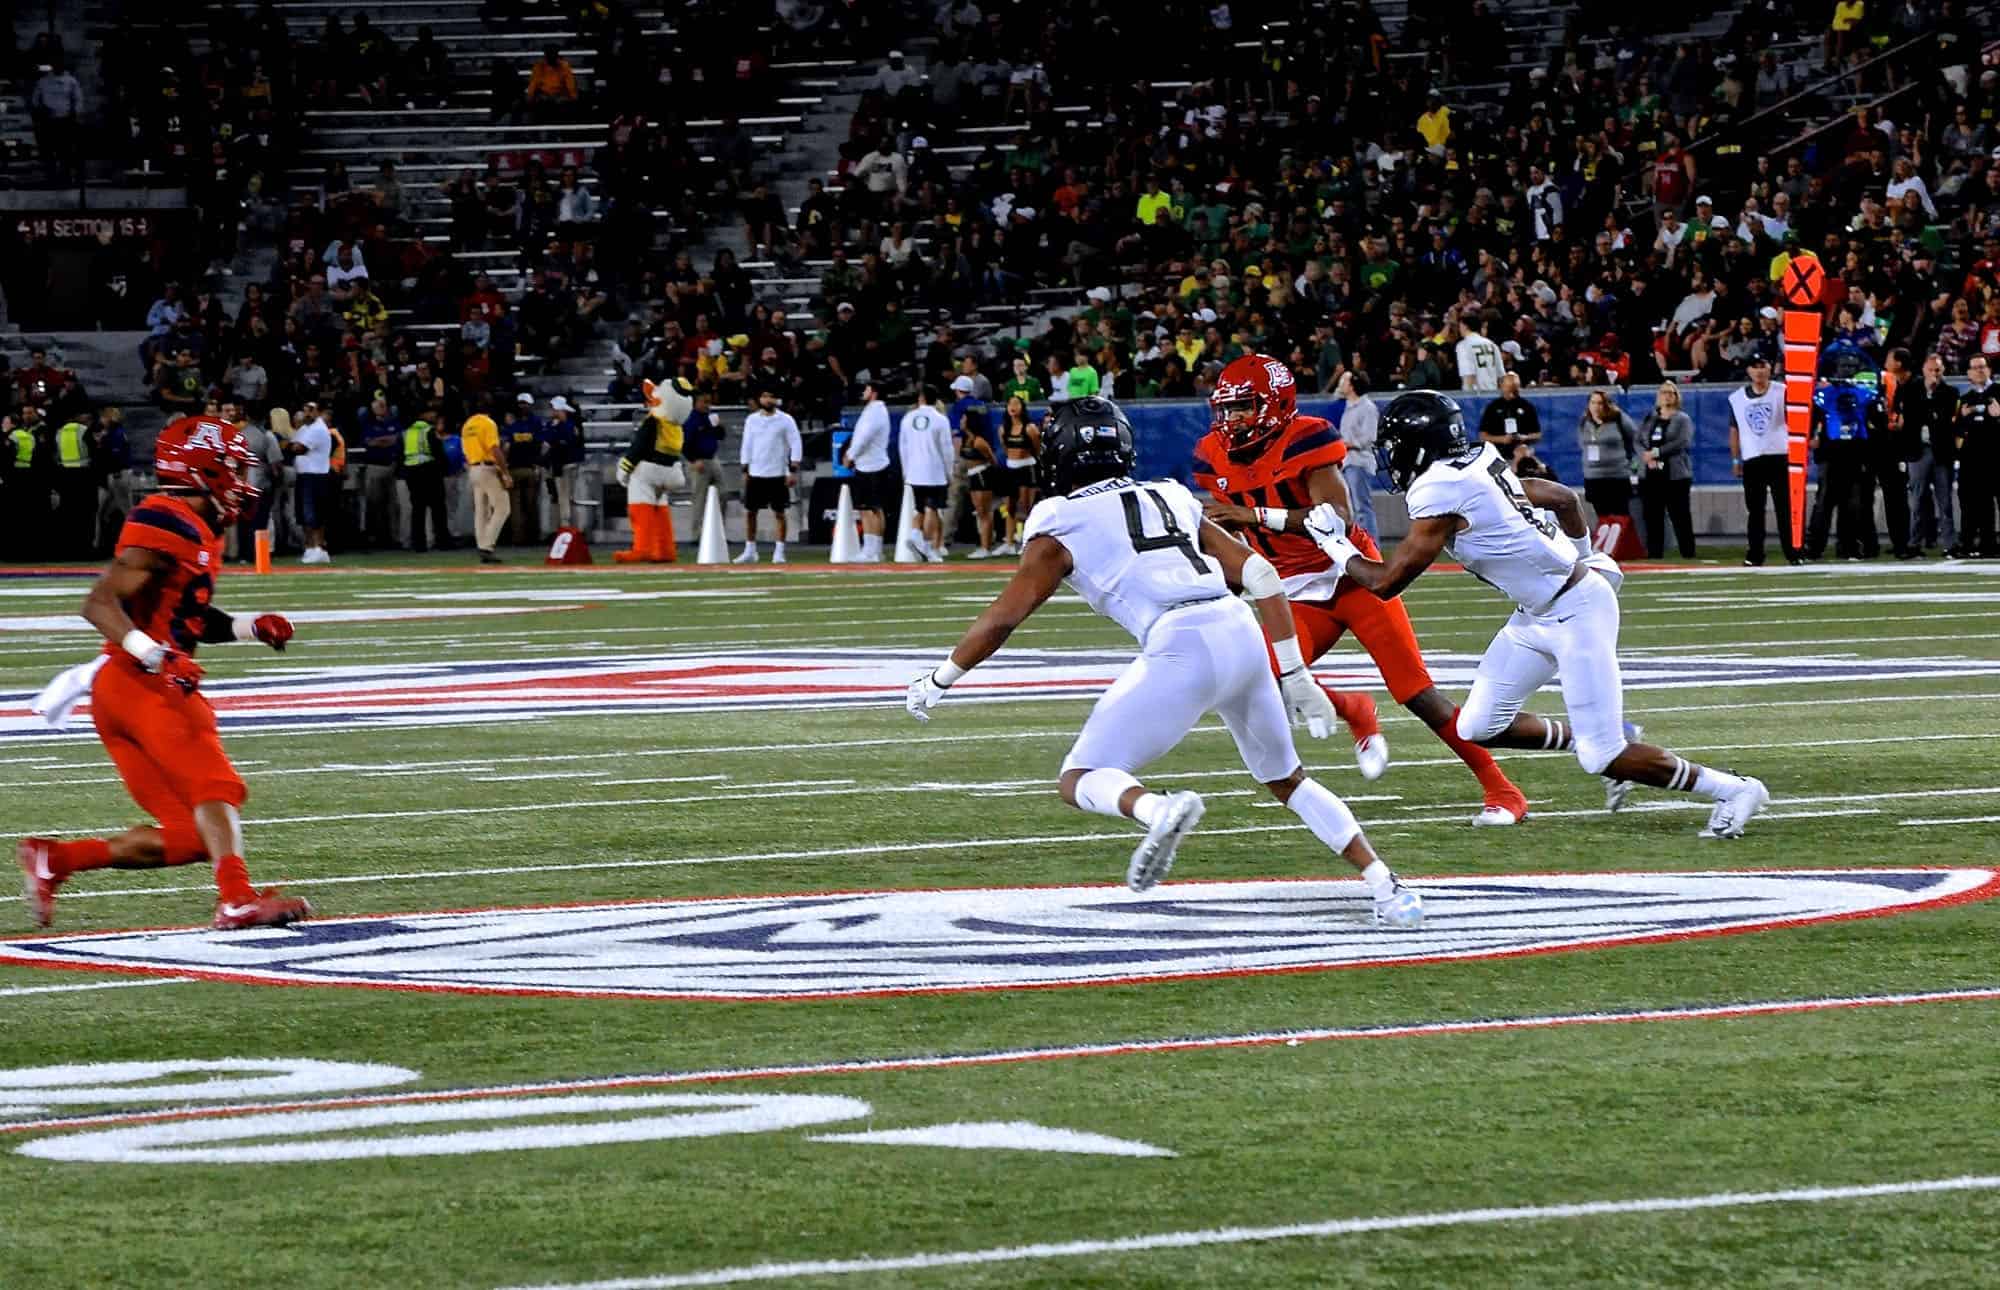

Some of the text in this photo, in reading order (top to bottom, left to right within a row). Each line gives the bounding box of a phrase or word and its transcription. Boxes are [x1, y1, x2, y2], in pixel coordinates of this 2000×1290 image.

[53, 218, 115, 238] SECTION
[1471, 344, 1496, 369] 24
[183, 422, 226, 453] A
[1119, 489, 1212, 575] 4
